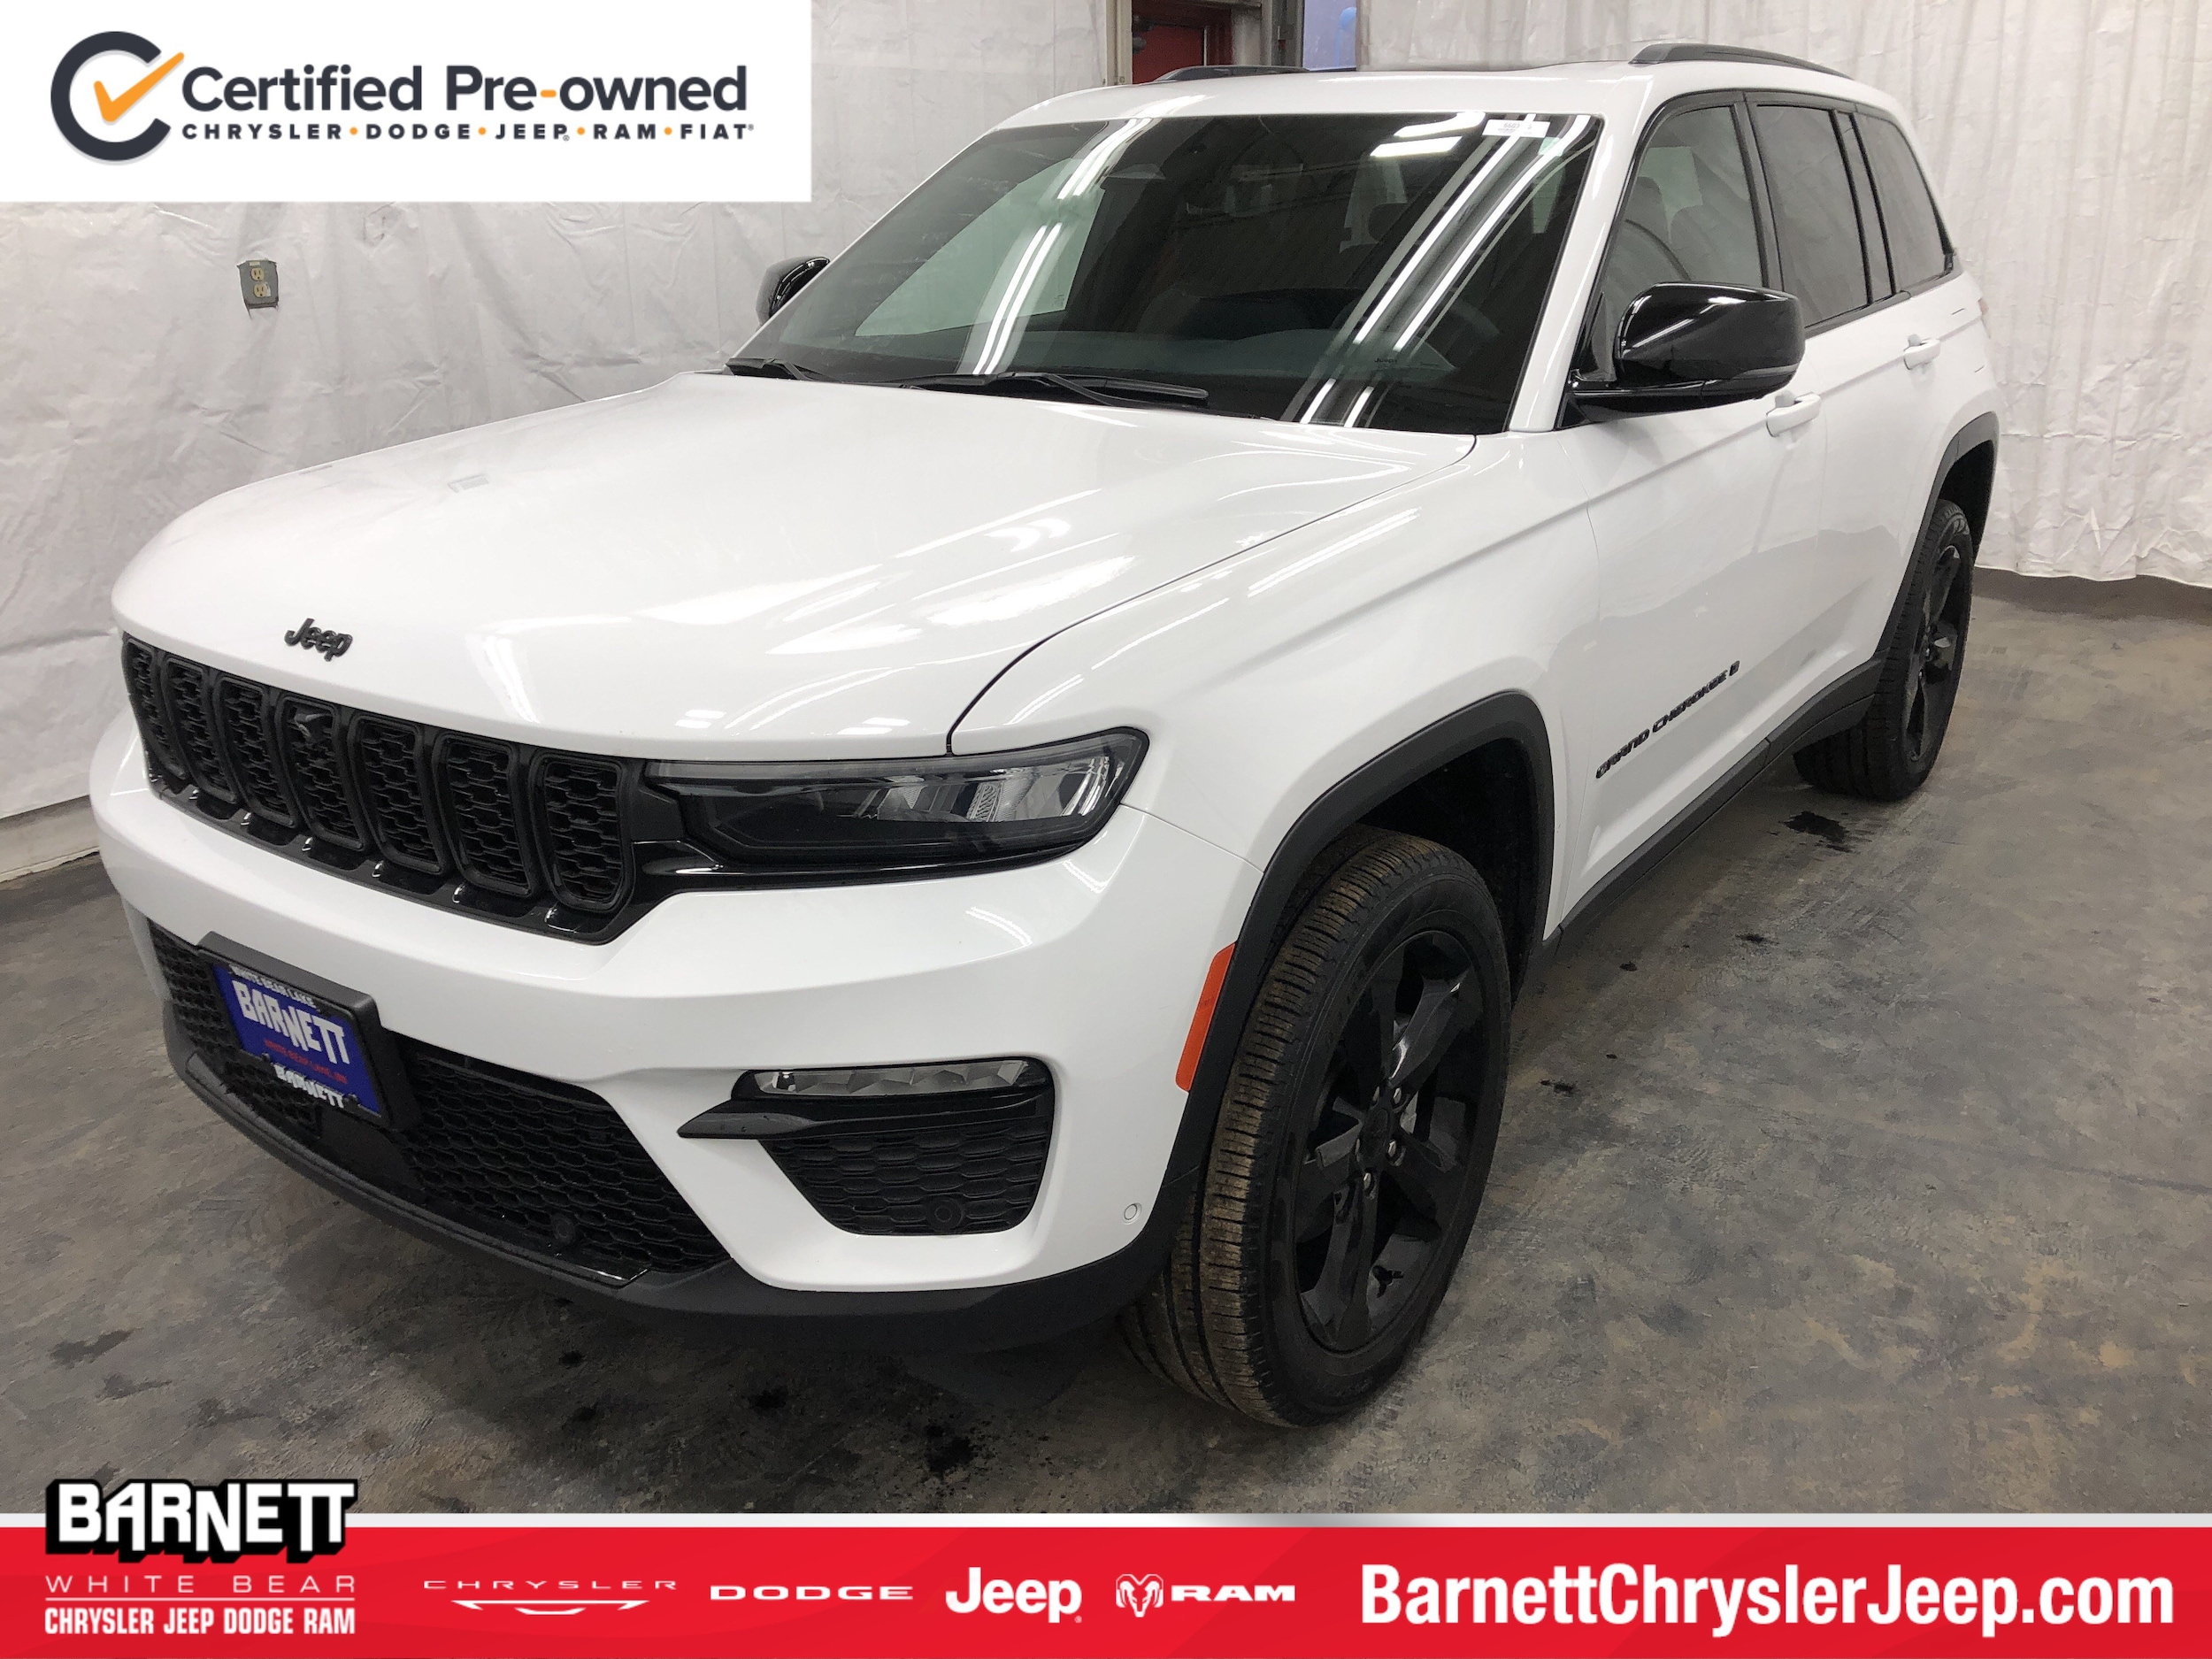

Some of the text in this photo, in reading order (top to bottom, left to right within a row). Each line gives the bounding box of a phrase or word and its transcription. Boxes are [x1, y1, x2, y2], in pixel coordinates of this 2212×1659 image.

[284, 618, 353, 662] Jeep
[1595, 669, 1728, 780] GRAND CHEROKEE
[232, 979, 350, 1065] BARNETT
[273, 1064, 344, 1109] BARNETT
